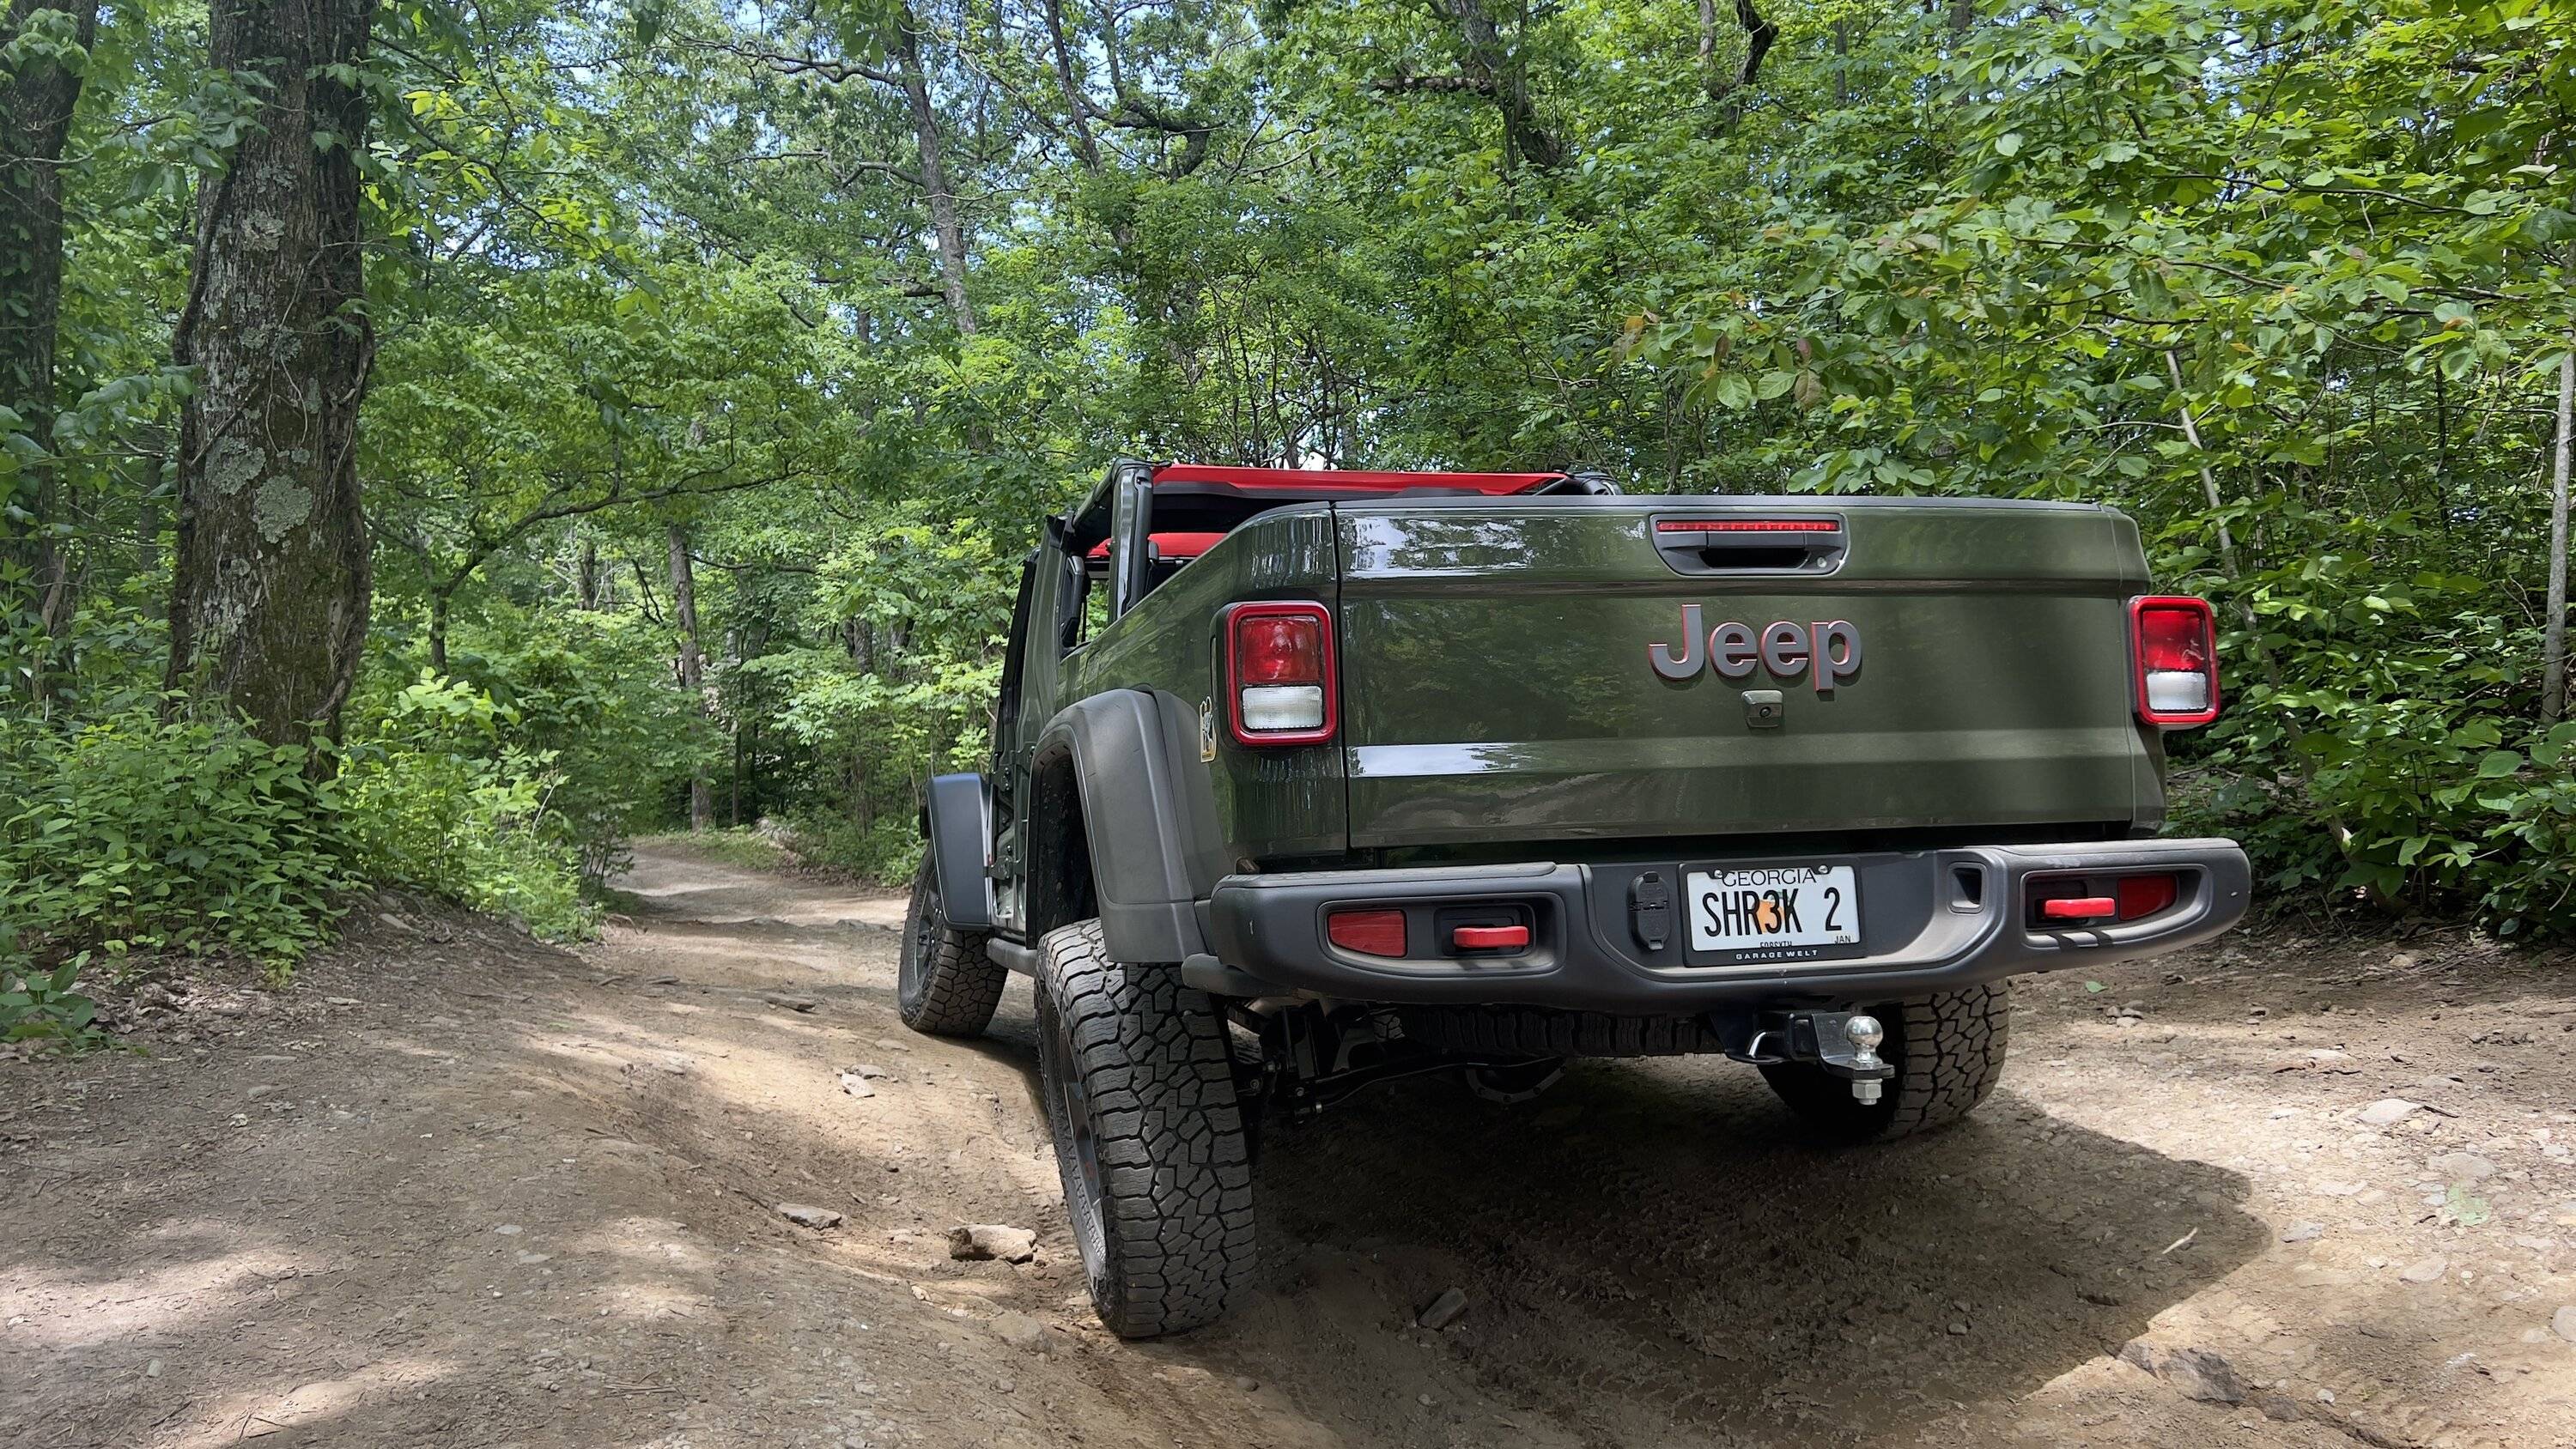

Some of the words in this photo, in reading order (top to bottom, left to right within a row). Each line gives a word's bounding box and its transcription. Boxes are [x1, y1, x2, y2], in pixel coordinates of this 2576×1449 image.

[1649, 603, 1861, 692] Jeep
[1722, 869, 1817, 887] GEORGIA
[1702, 888, 1802, 937] SHR3K
[1824, 887, 1842, 931] 2
[1834, 935, 1851, 944] JAN
[1785, 949, 1818, 958] WELT
